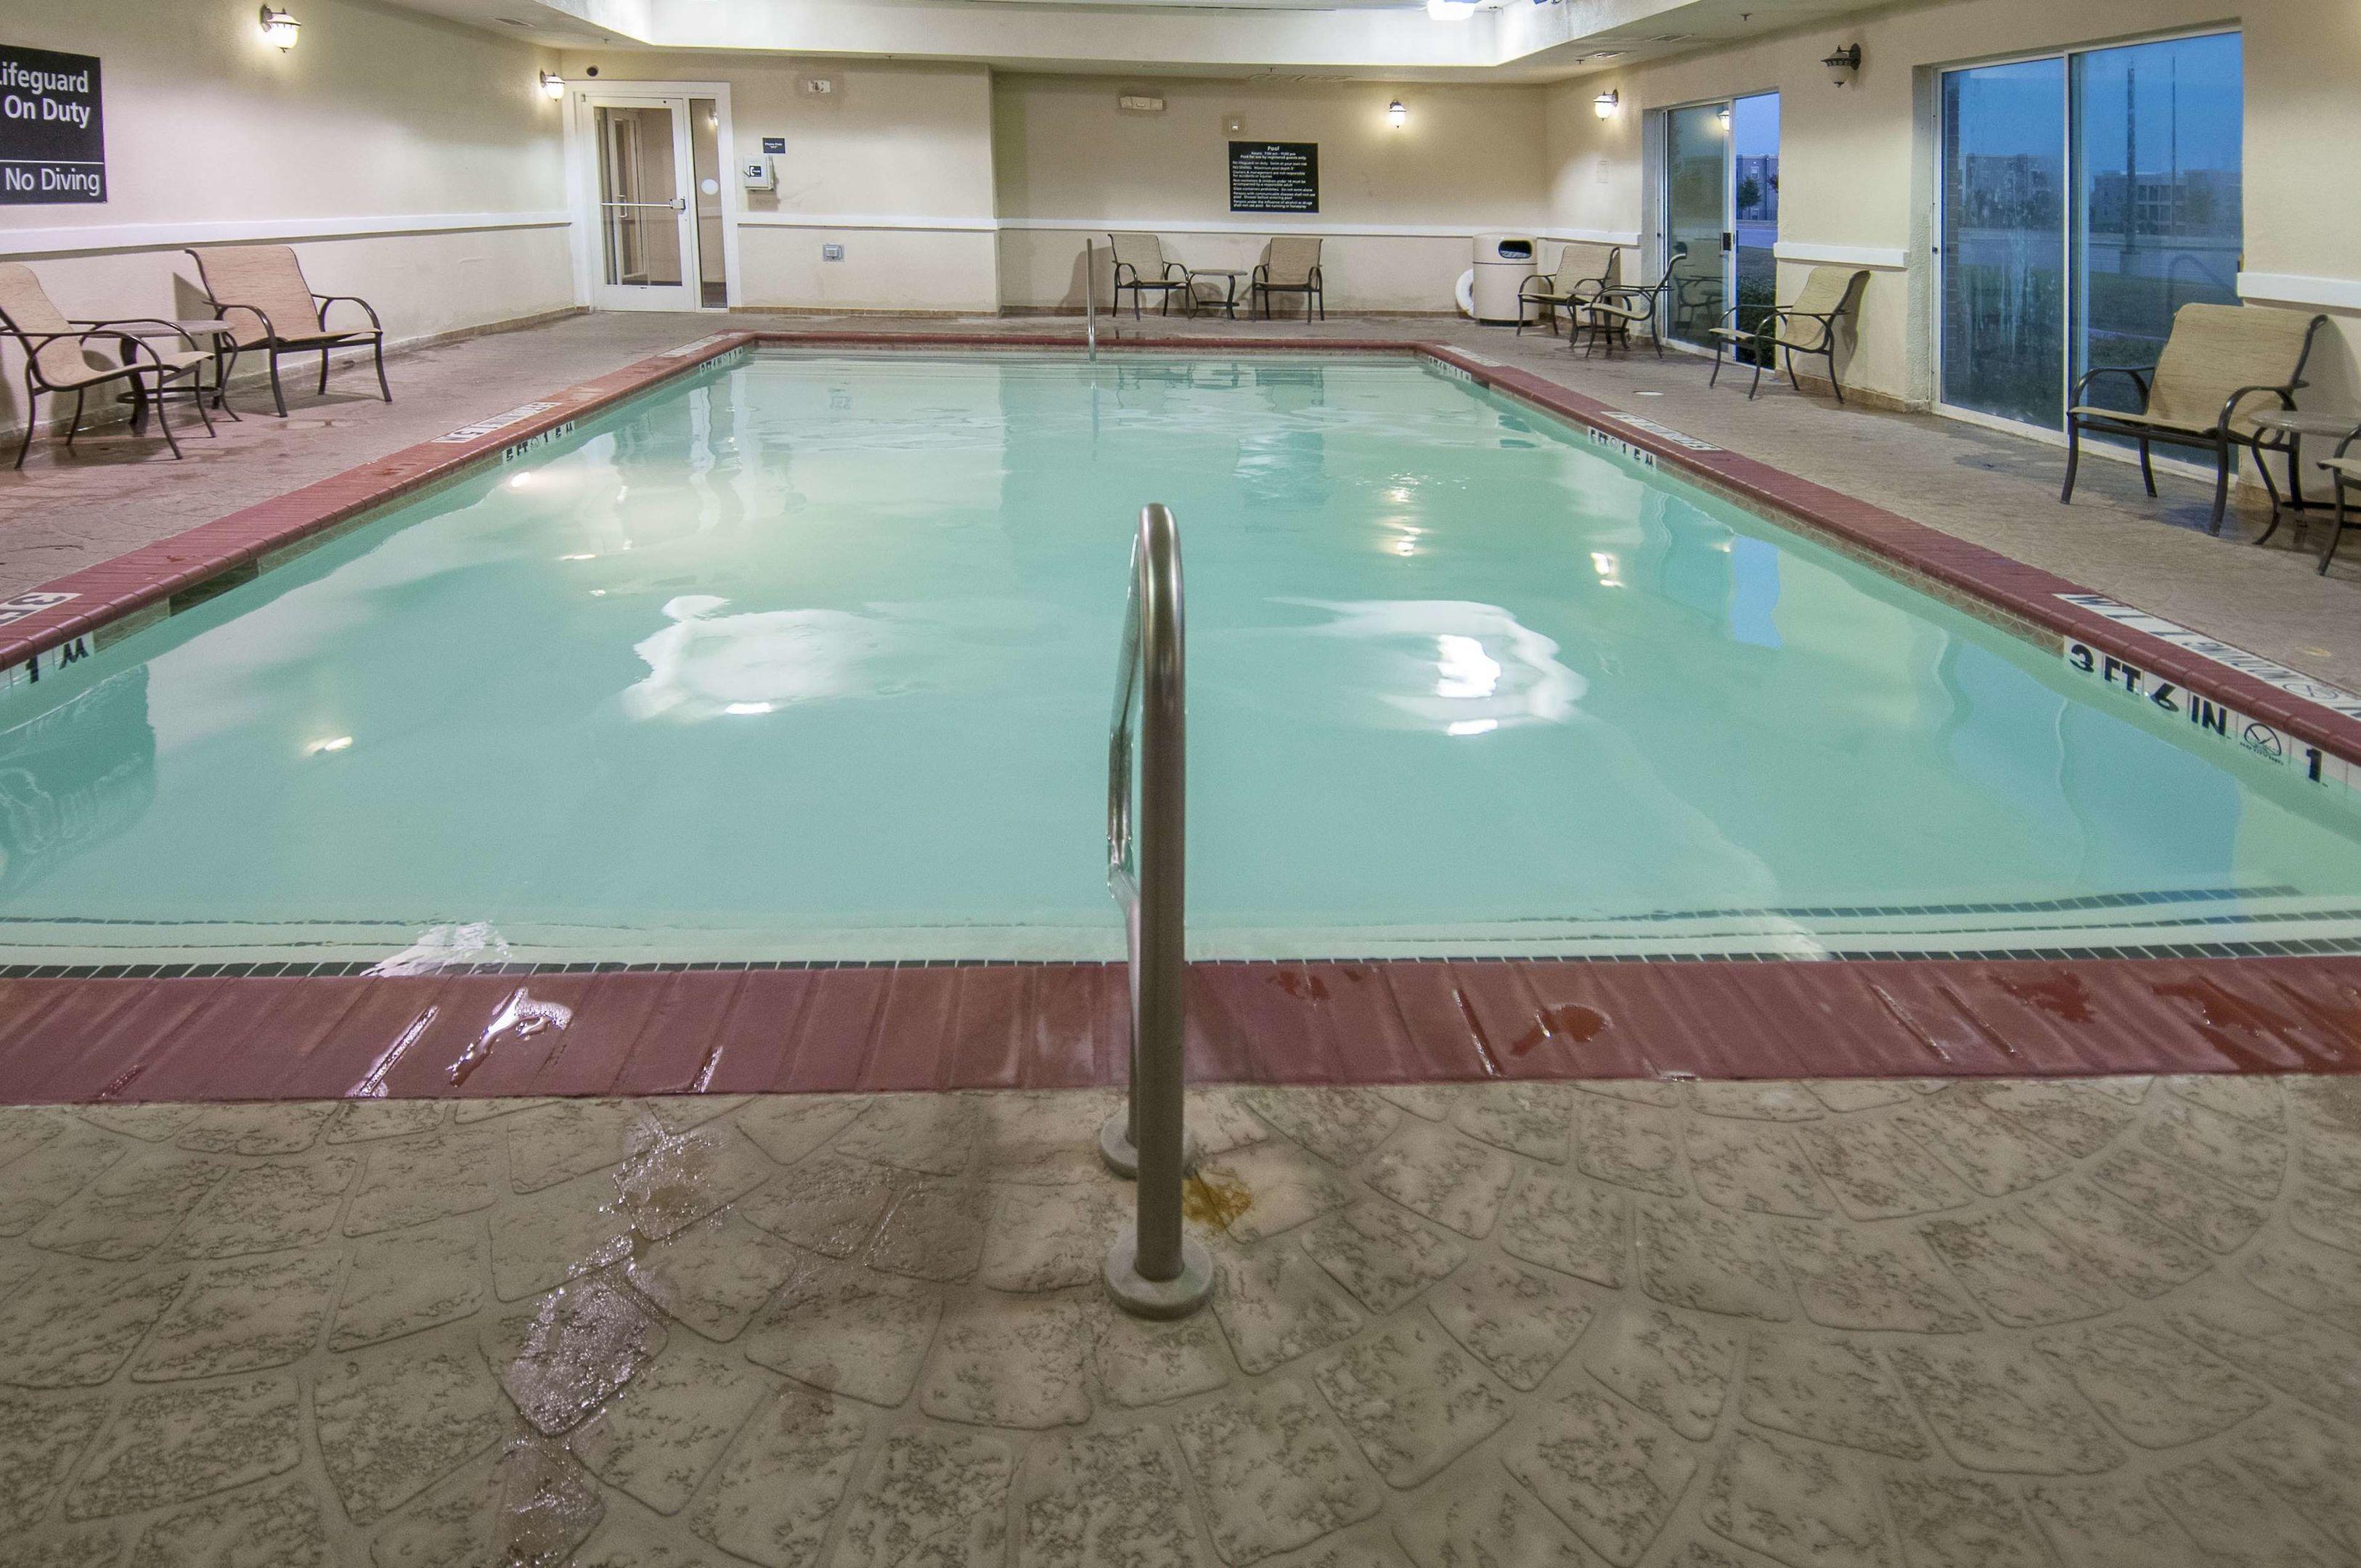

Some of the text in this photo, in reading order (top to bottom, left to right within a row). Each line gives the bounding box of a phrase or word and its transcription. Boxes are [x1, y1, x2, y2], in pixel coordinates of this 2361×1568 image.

[4, 95, 90, 128] On Duty
[5, 167, 99, 197] No Diving
[59, 637, 89, 671] M
[2070, 645, 2094, 672] 3
